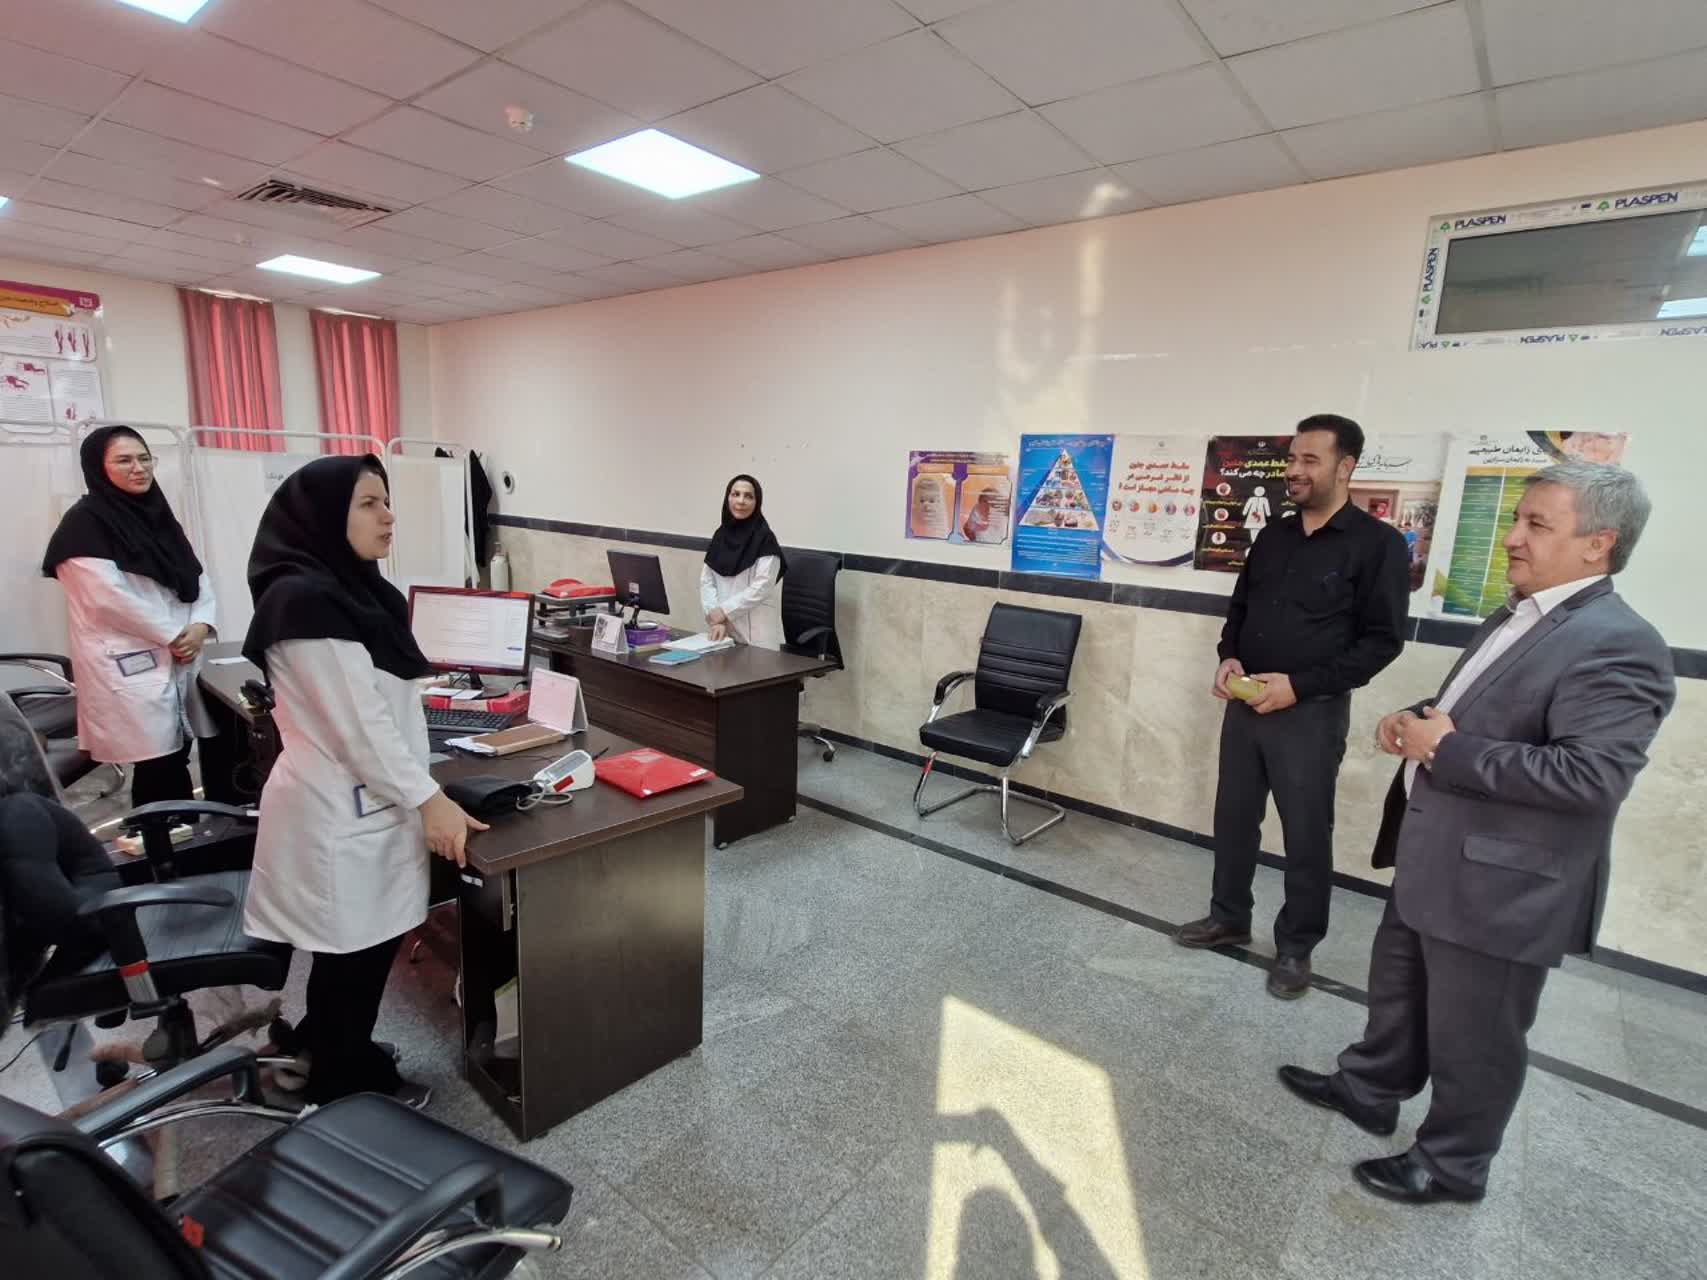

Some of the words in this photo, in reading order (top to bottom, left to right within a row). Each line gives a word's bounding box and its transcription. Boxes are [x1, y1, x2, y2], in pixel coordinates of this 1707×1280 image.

[1614, 191, 1679, 210] PLASPEN
[1454, 213, 1507, 231] PLASPEN
[1423, 247, 1439, 292] PLASPEN
[1519, 334, 1566, 345] PLASPEN
